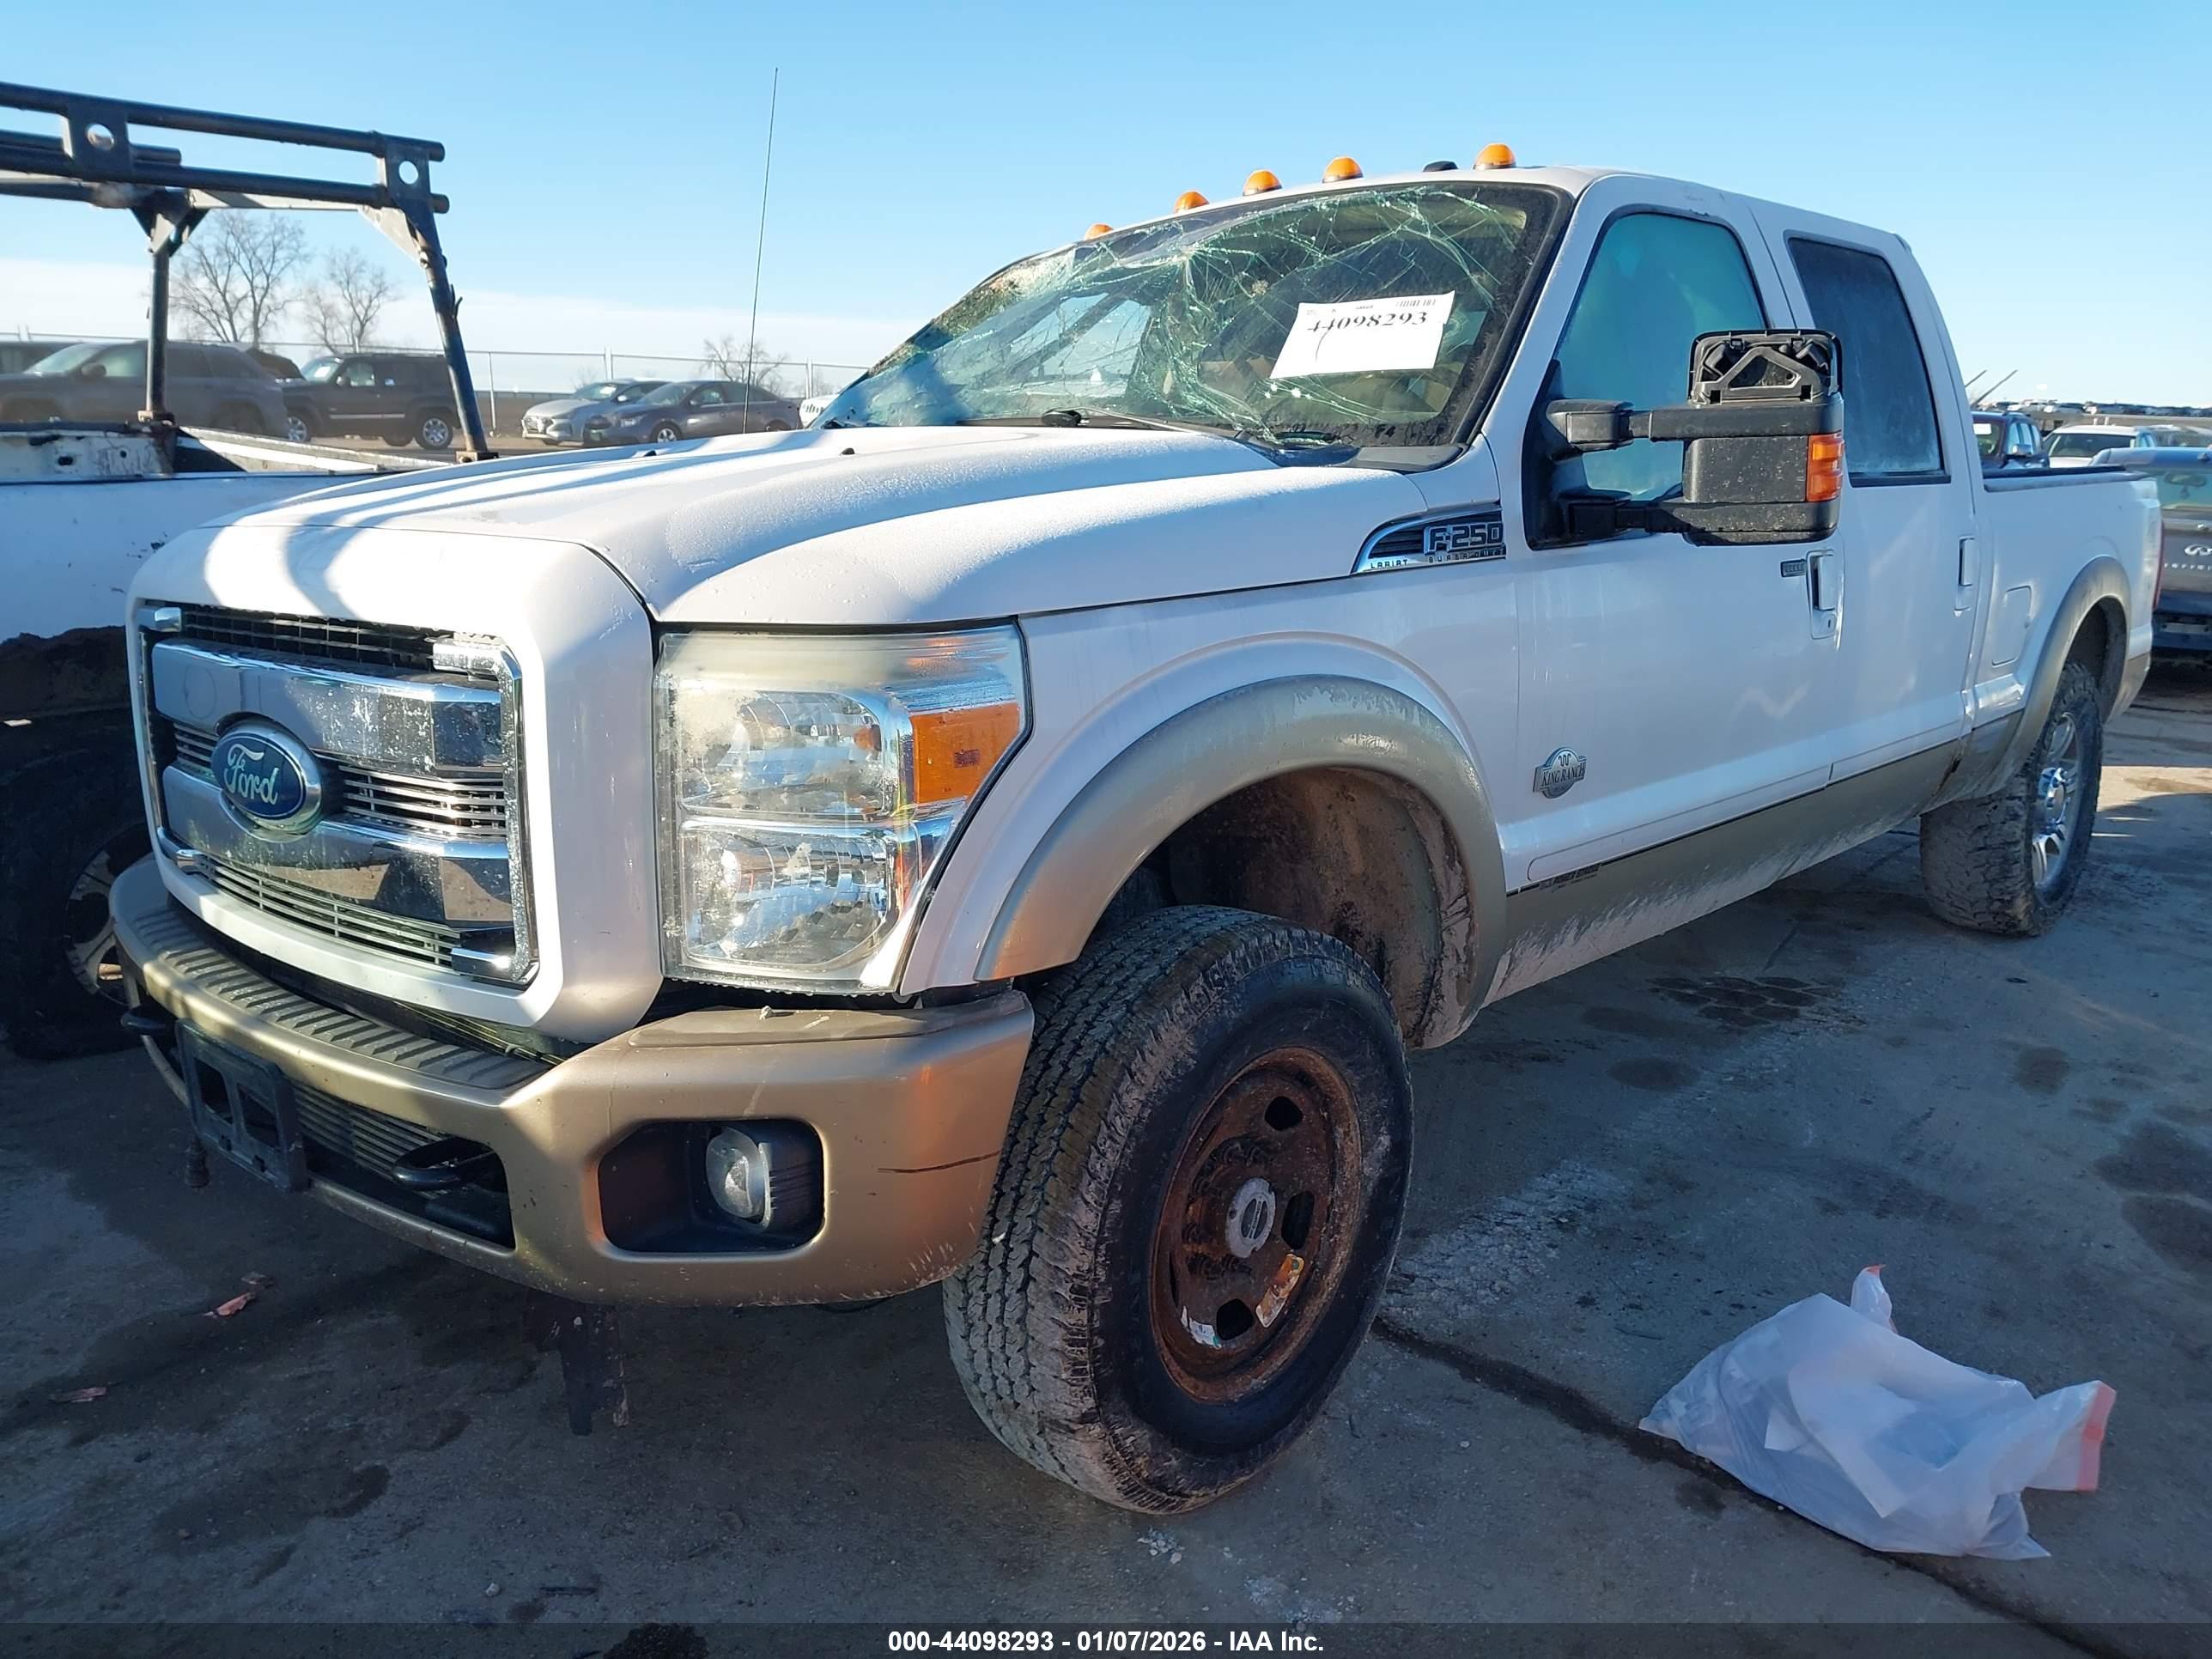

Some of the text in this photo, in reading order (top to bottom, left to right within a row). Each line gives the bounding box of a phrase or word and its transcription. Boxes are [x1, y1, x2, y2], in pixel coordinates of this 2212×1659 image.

[1307, 311, 1427, 333] 44098293
[1425, 521, 1504, 554] F-250
[1370, 559, 1408, 569] LARIAT
[1428, 552, 1468, 563] SUPER
[224, 744, 279, 805] Ford
[1542, 769, 1560, 787] KING
